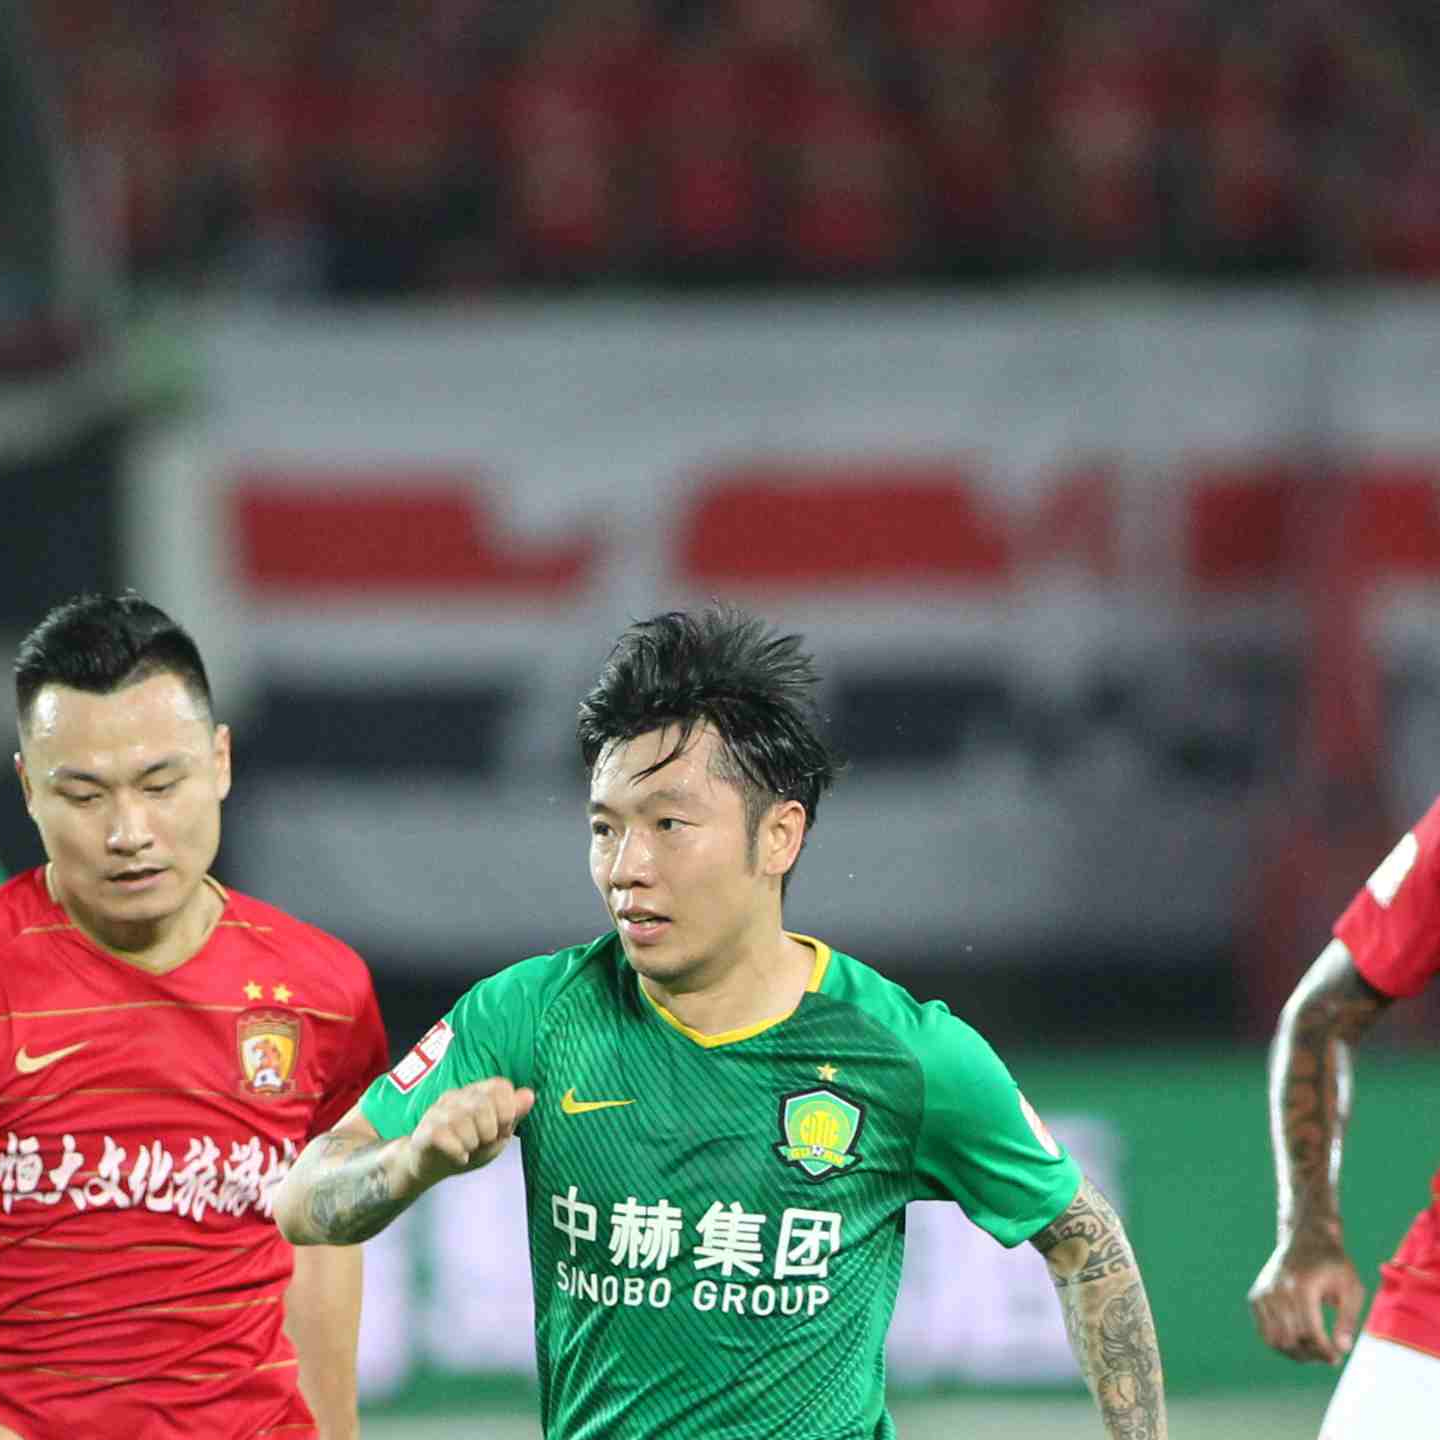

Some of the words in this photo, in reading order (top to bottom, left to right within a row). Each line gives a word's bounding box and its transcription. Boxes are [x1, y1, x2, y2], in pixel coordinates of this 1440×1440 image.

[550, 1185, 843, 1280] 中赫集团
[556, 1260, 672, 1309] SINOBO
[691, 1279, 831, 1317] GROUP
